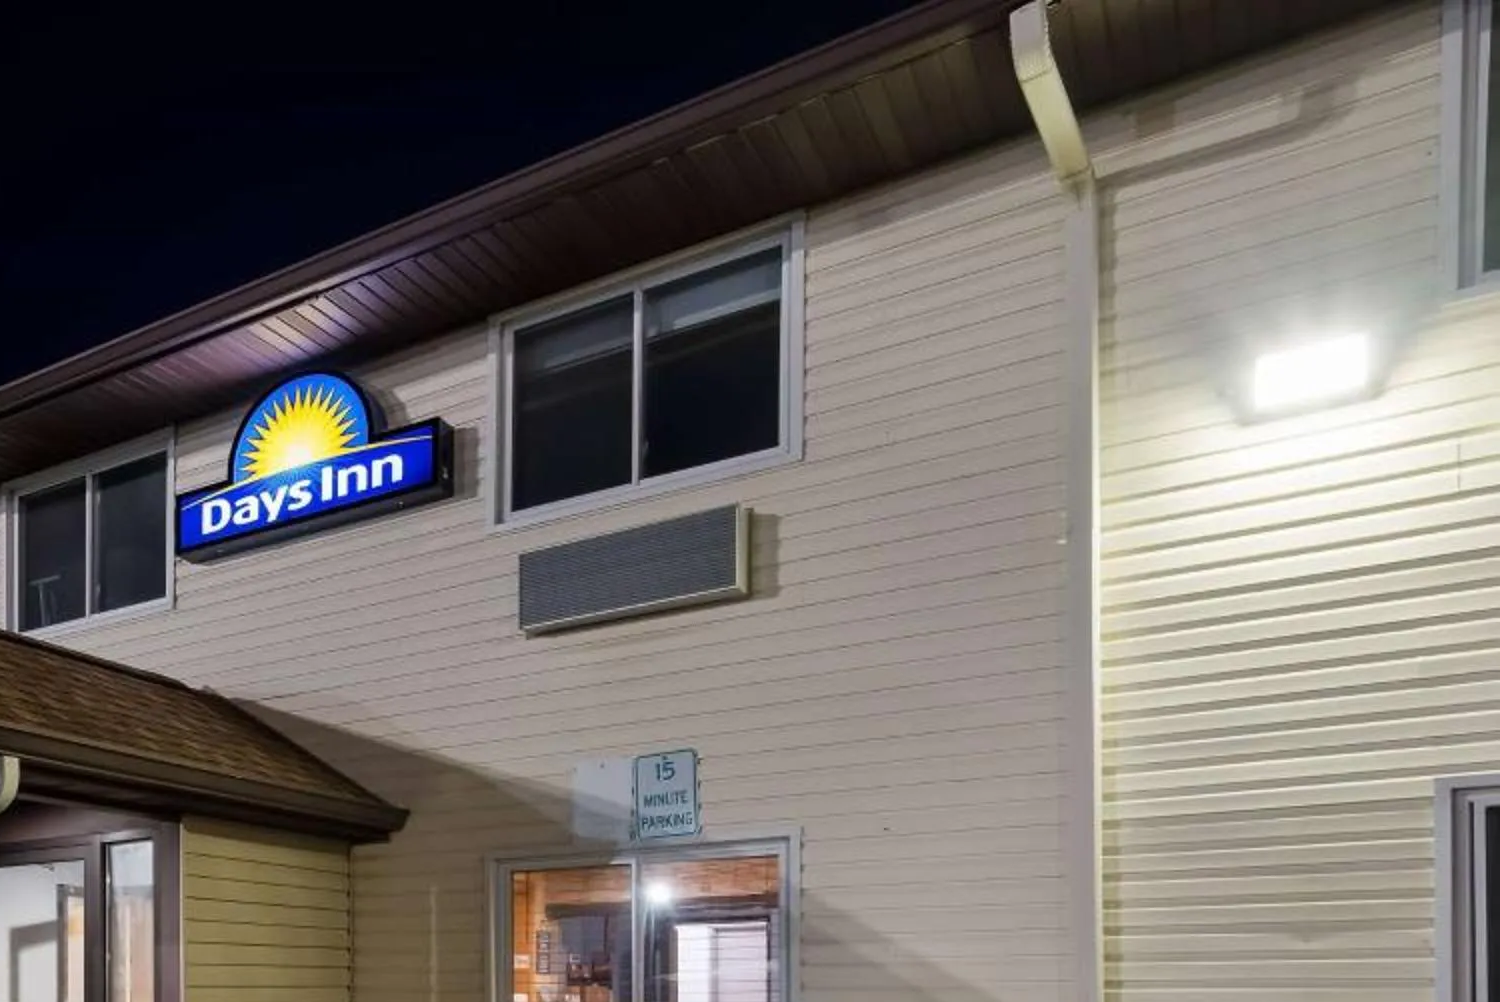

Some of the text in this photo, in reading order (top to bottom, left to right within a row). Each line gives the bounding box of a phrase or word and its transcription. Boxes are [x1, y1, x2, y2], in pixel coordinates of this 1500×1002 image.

[201, 453, 403, 535] Days Inn
[656, 761, 675, 780] 15
[643, 790, 688, 808] MINUTE
[641, 812, 693, 830] PARKING
